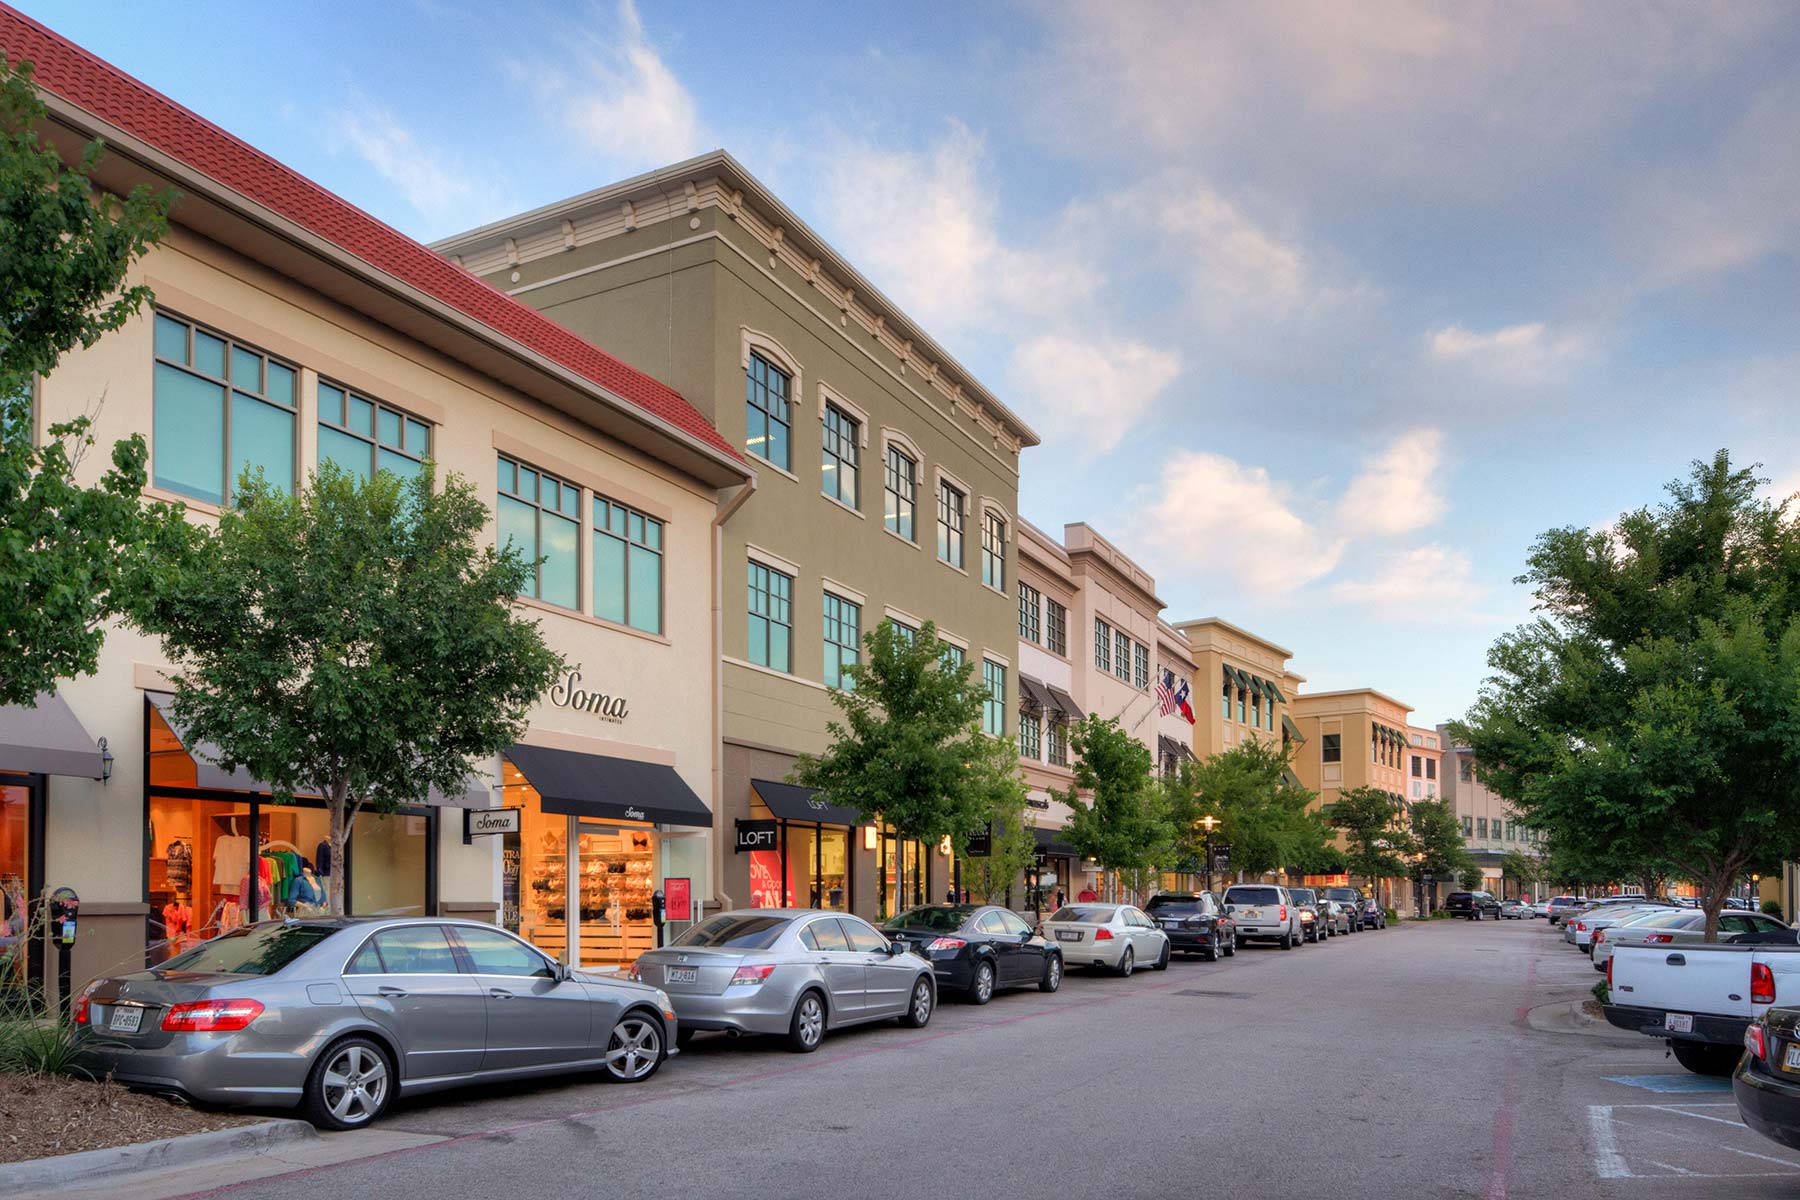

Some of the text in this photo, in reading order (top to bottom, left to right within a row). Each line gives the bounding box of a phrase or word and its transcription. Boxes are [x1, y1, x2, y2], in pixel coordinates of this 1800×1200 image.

[550, 671, 629, 719] Soma
[624, 806, 645, 819] Soma
[476, 813, 511, 830] Soma
[740, 831, 774, 845] LOFT
[750, 864, 769, 879] OVE
[503, 911, 519, 921] ALE
